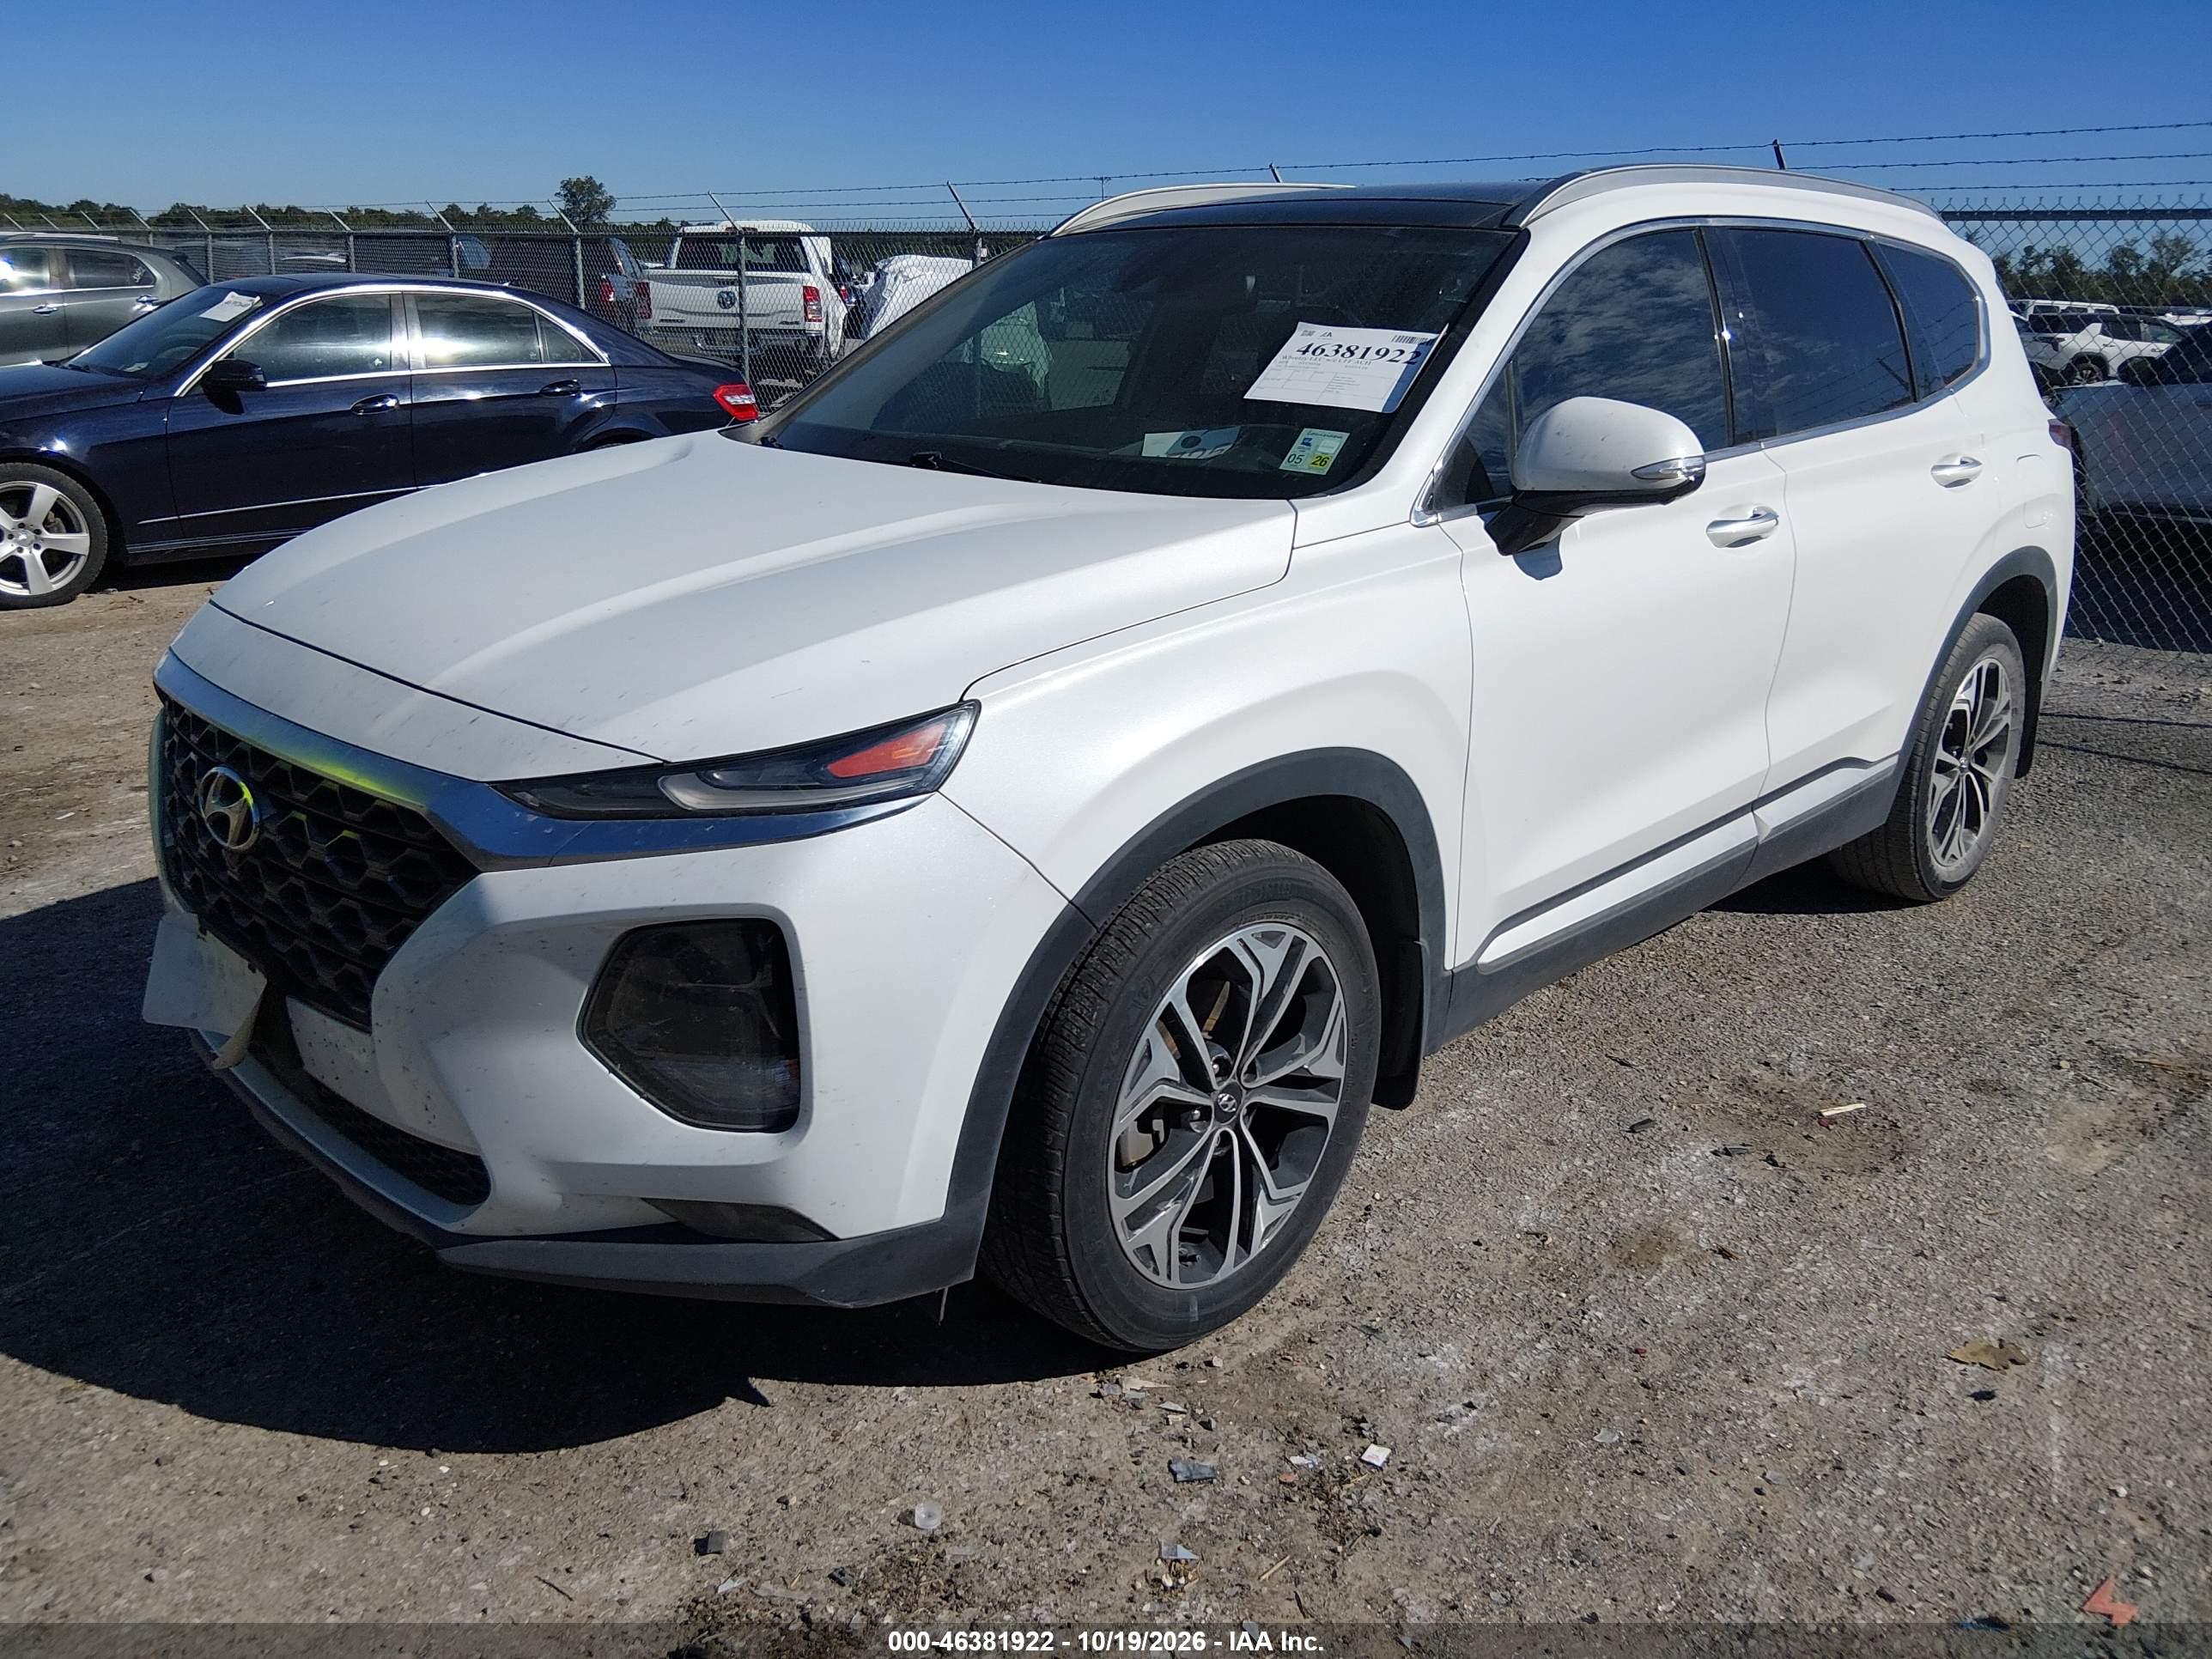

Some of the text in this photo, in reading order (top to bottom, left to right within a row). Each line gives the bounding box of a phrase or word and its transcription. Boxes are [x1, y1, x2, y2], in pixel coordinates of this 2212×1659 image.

[1296, 343, 1422, 365] 46381922
[1287, 453, 1305, 465] 05
[1311, 455, 1330, 467] 26
